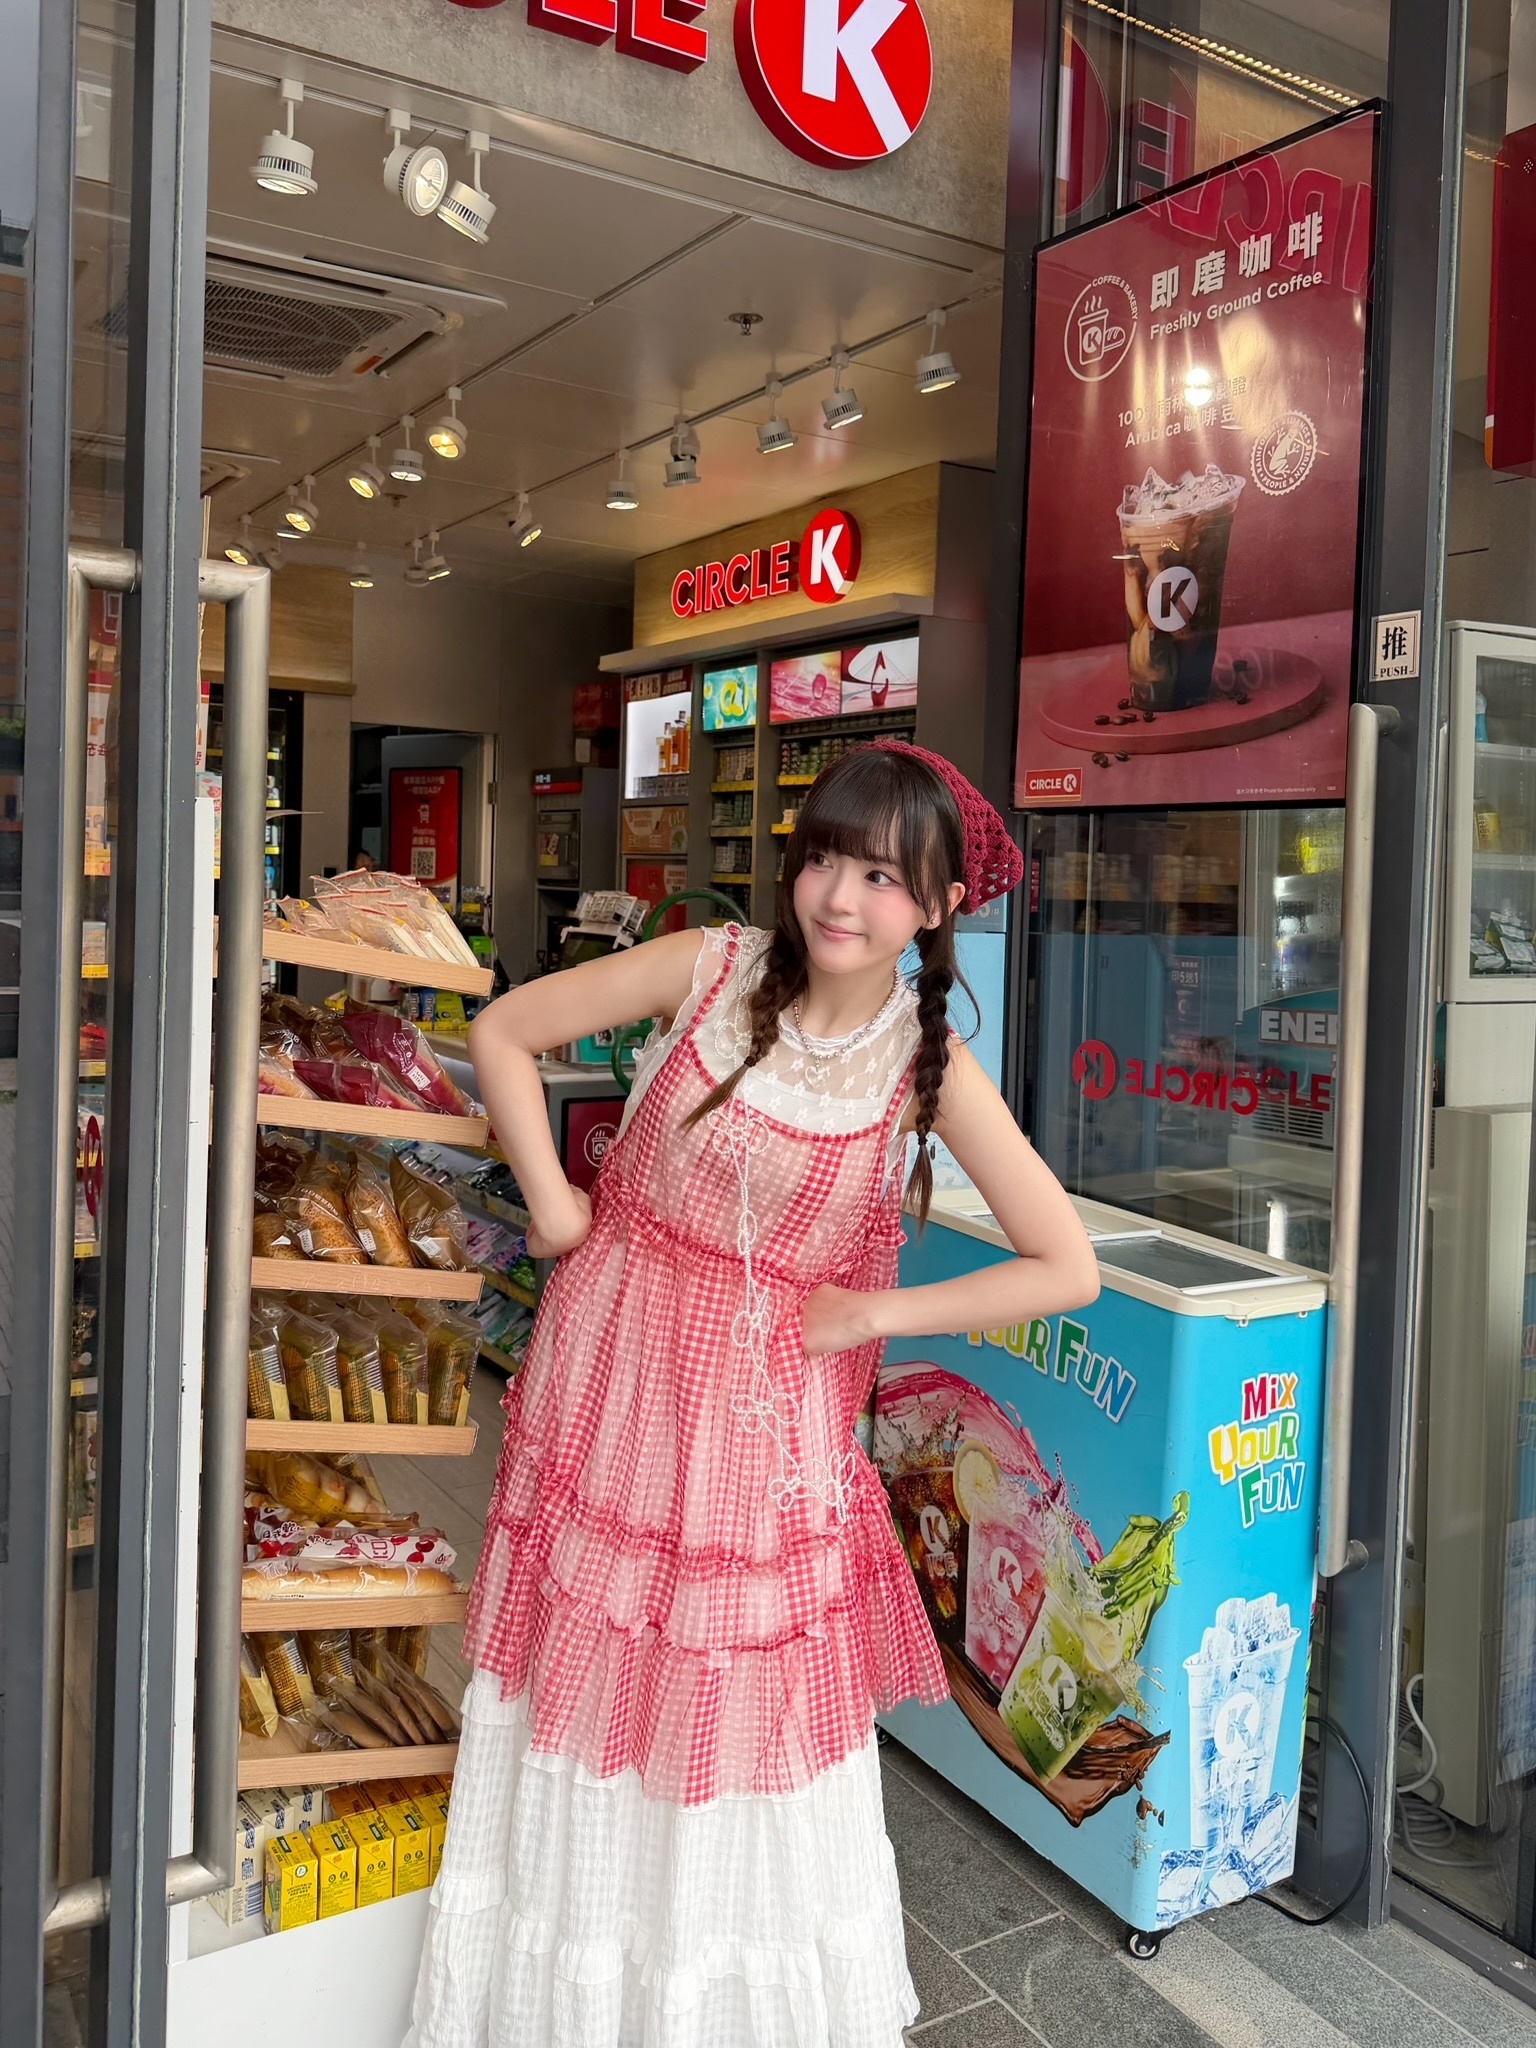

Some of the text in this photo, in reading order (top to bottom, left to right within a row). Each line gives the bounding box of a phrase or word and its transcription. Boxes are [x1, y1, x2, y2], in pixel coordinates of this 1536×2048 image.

[803, 0, 911, 153] K
[1150, 211, 1323, 312] 即磨咖啡
[1092, 275, 1121, 287] COFFEE
[1123, 284, 1139, 320] BAKERY
[1150, 271, 1323, 340] Freshly Ground Coffee
[1261, 475, 1287, 490] PEOPLE
[671, 517, 853, 618] CIRCLE K
[1380, 665, 1408, 678] PUSH
[1382, 626, 1407, 661] 推
[1029, 775, 1077, 792] CIRCLE K
[1054, 1316, 1137, 1423] FUN
[1208, 1412, 1300, 1485] YOUR
[1238, 1462, 1306, 1529] FUN
